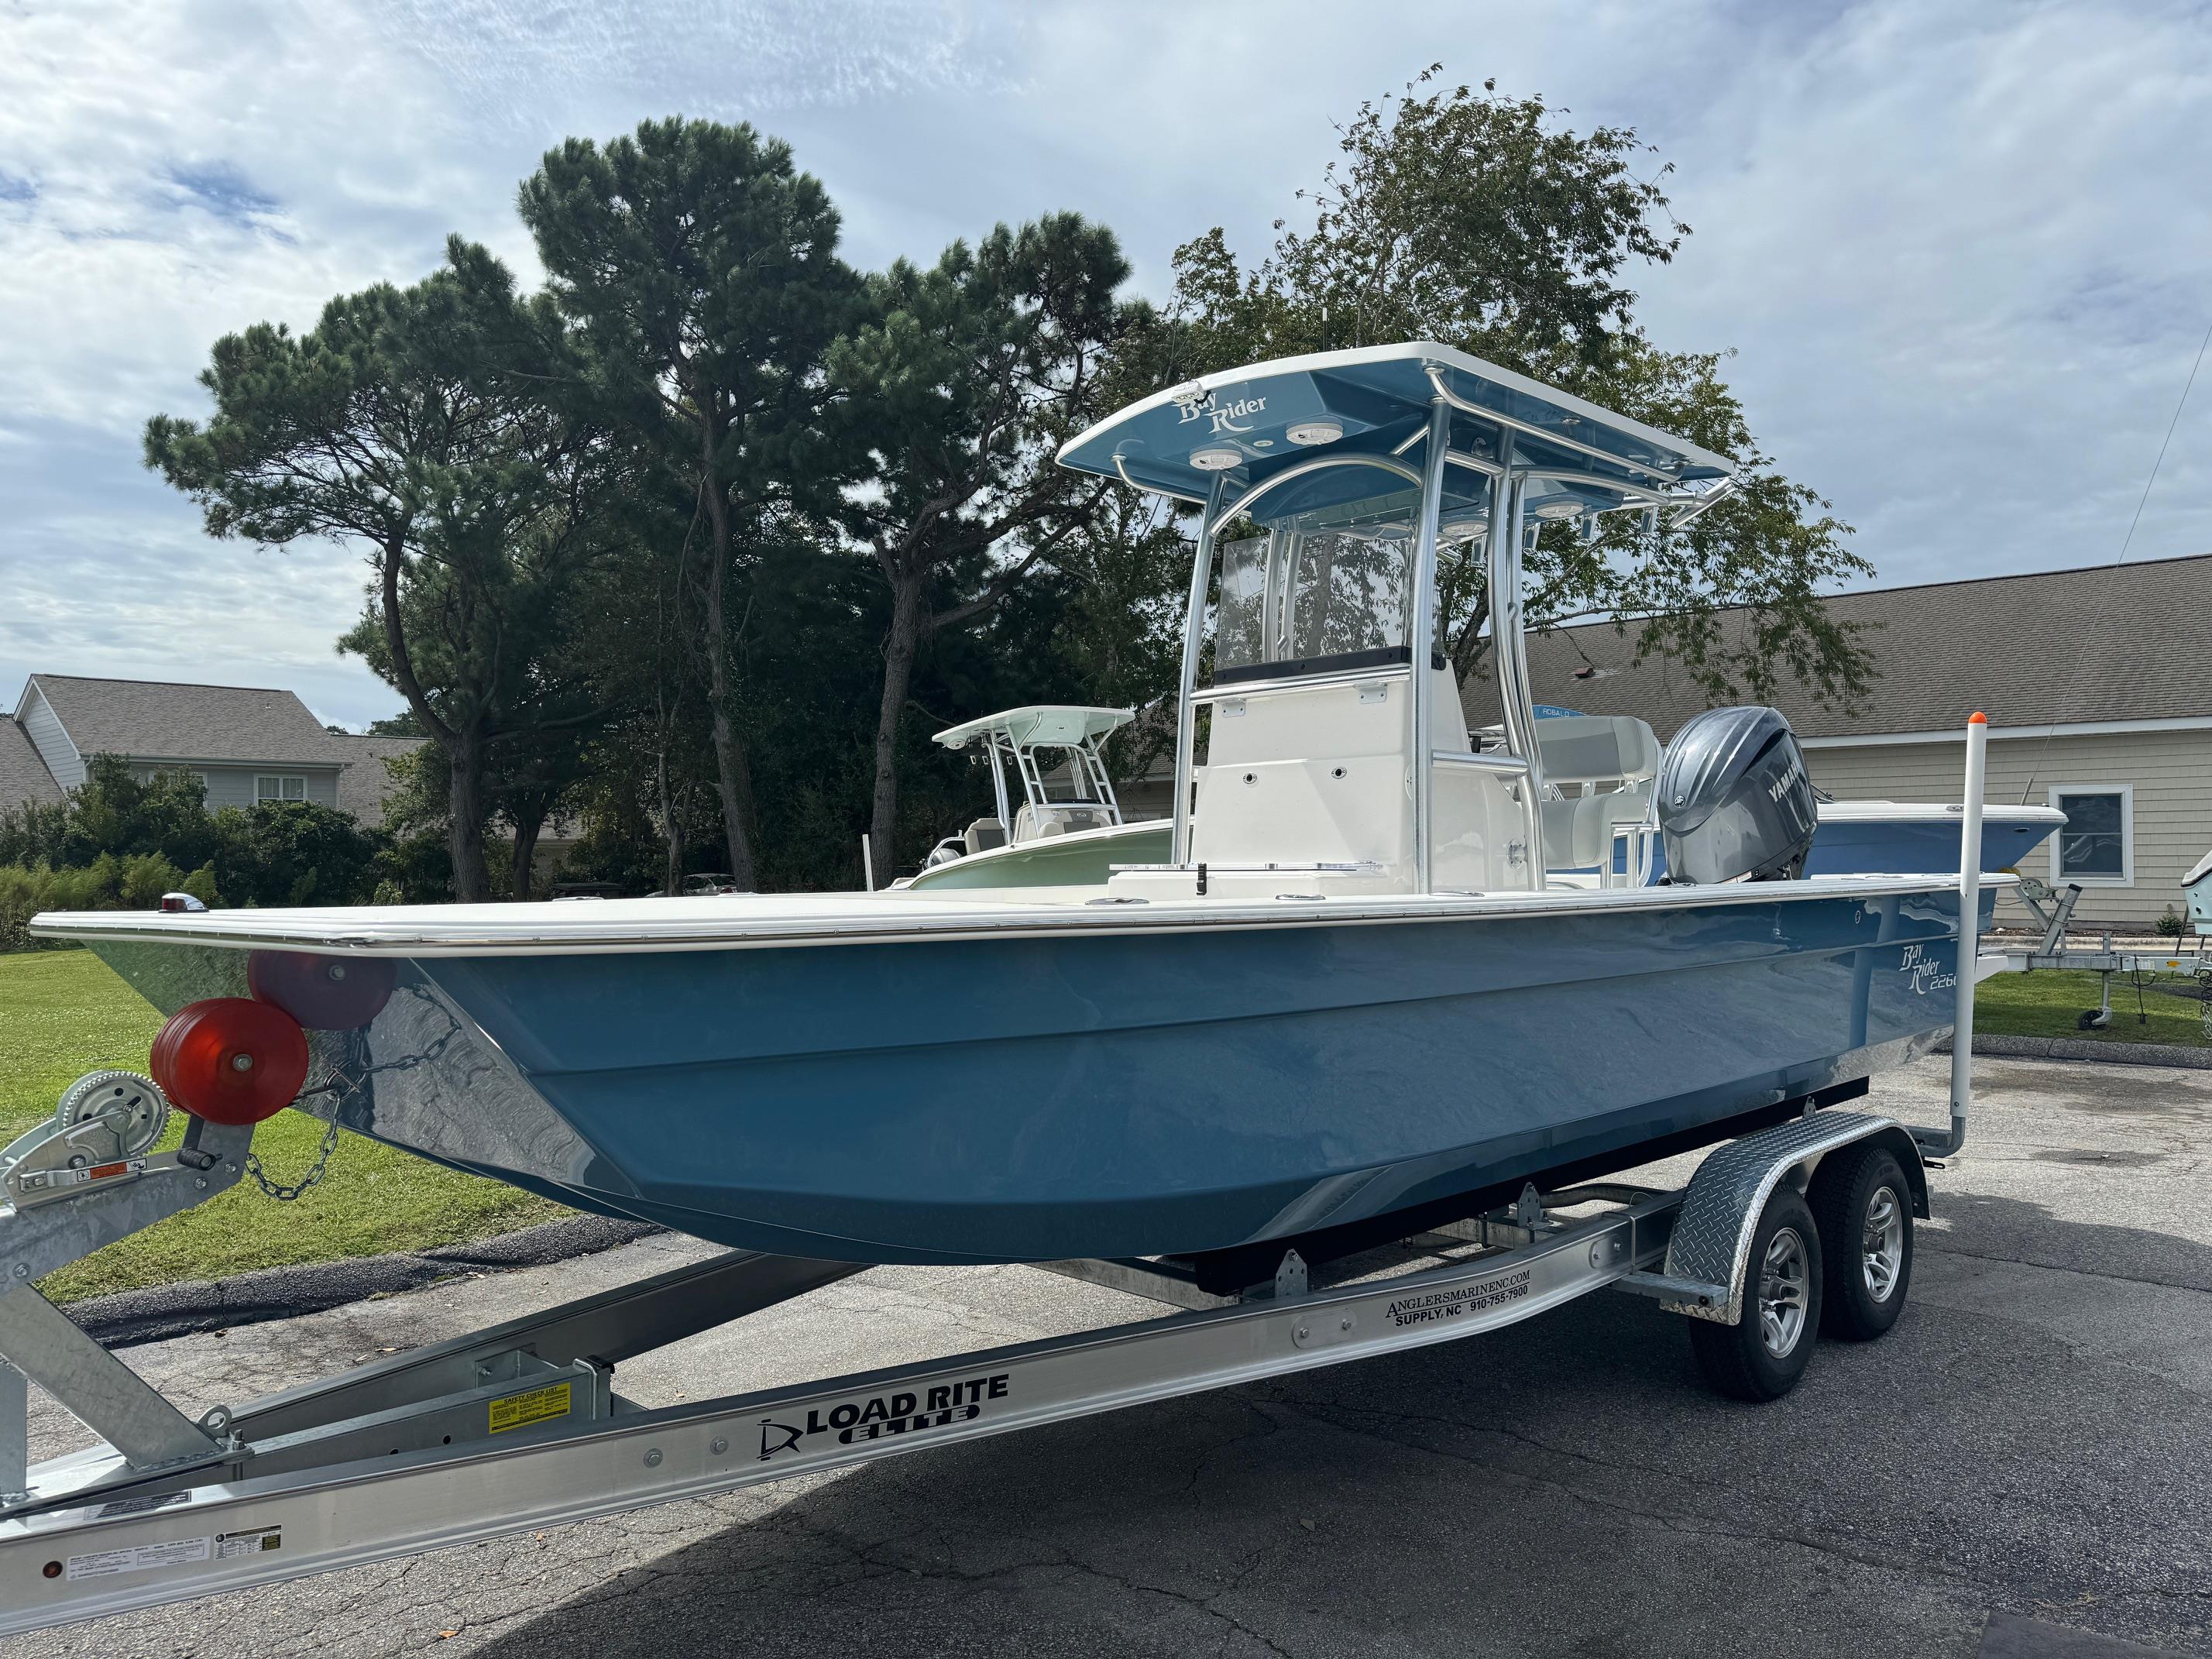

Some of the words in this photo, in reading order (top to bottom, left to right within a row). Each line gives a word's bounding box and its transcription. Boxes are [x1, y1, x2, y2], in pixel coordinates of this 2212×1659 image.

[1203, 397, 1266, 434] Rider
[1543, 708, 1570, 718] ROBALO
[1898, 944, 1925, 972] Bay
[1908, 958, 1940, 995] Rider
[1385, 1270, 1530, 1318] ANGLERSMARINENC.COM
[1396, 1308, 1444, 1327] SUPPLY,
[1446, 1304, 1462, 1317] NC
[1470, 1284, 1528, 1311] 910-755-7900
[503, 1394, 525, 1404] SAFETY
[526, 1389, 545, 1399] CHECK
[806, 1392, 917, 1435] LOAD
[927, 1373, 1010, 1411] RITE
[850, 1406, 970, 1443] ELITE
